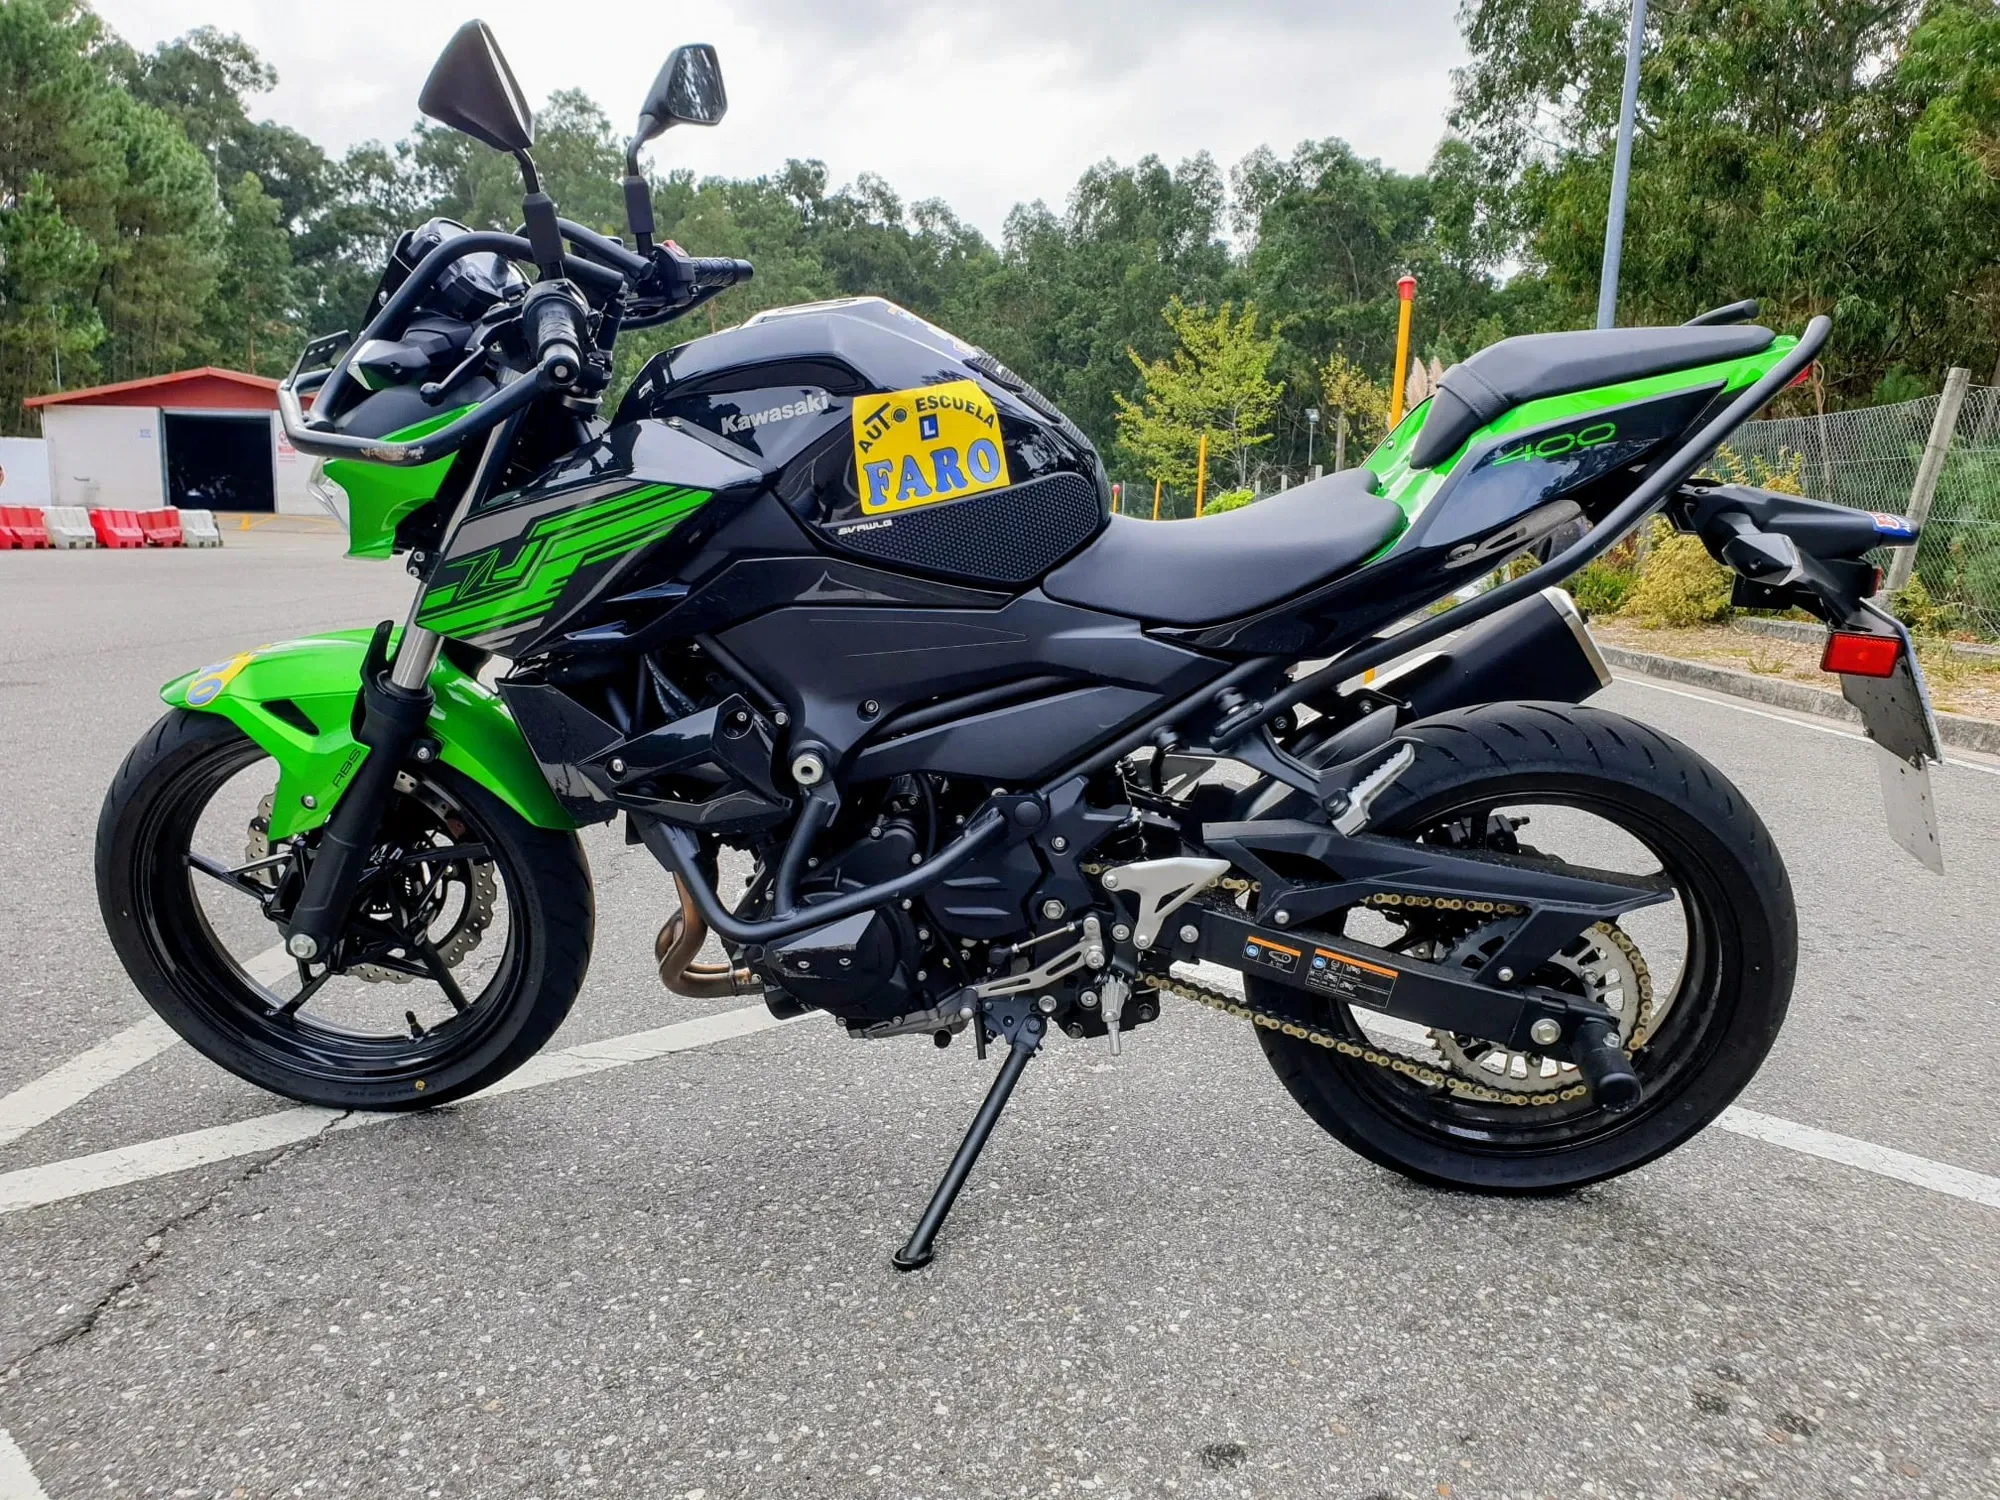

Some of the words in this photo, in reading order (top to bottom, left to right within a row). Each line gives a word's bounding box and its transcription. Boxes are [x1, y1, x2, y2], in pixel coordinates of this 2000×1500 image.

[720, 391, 830, 436] Kawasaki
[915, 395, 995, 429] ESCUELA
[923, 420, 936, 437] L
[1491, 422, 1617, 467] 400
[863, 437, 1001, 507] FARO
[332, 748, 361, 788] ABS
